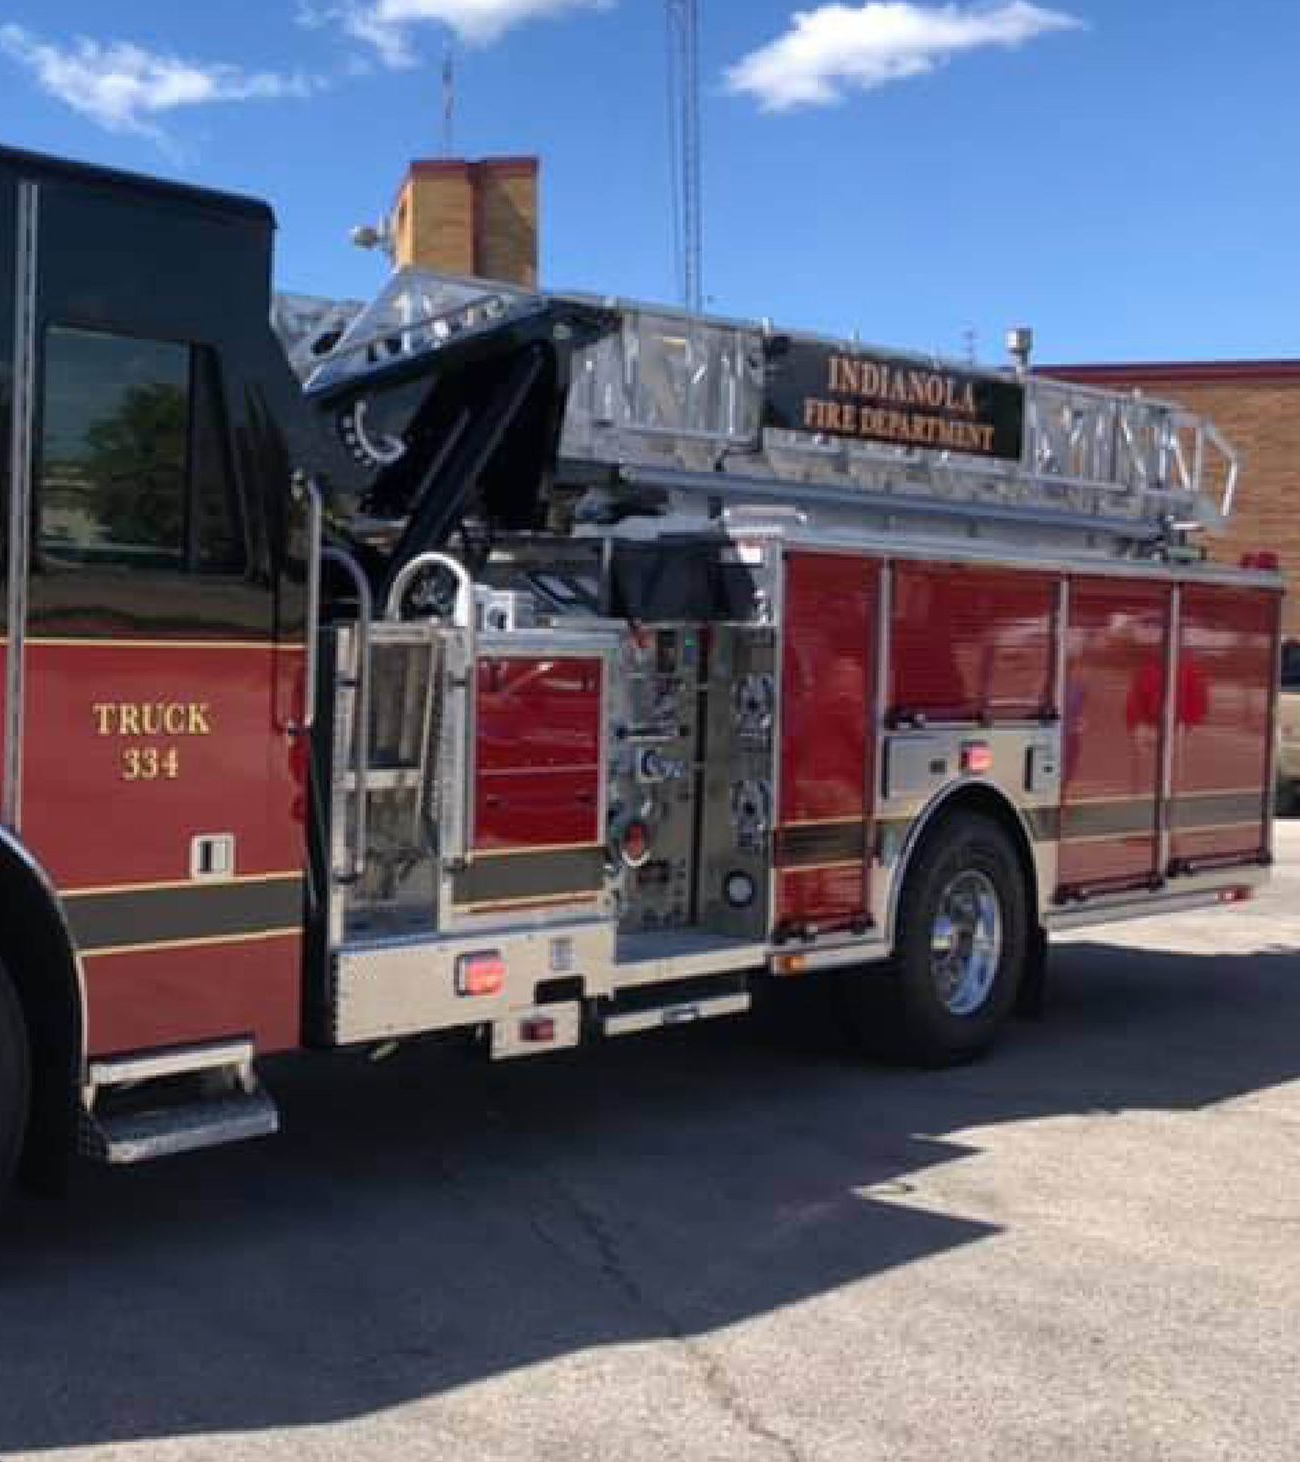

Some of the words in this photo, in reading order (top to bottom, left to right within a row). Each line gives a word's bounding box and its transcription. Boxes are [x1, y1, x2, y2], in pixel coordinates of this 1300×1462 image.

[828, 356, 974, 411] INDIANOLA
[804, 398, 856, 430] FIRE
[860, 406, 995, 450] DEPARTMENT
[93, 702, 211, 734] TRUCK
[122, 746, 178, 780] 334
